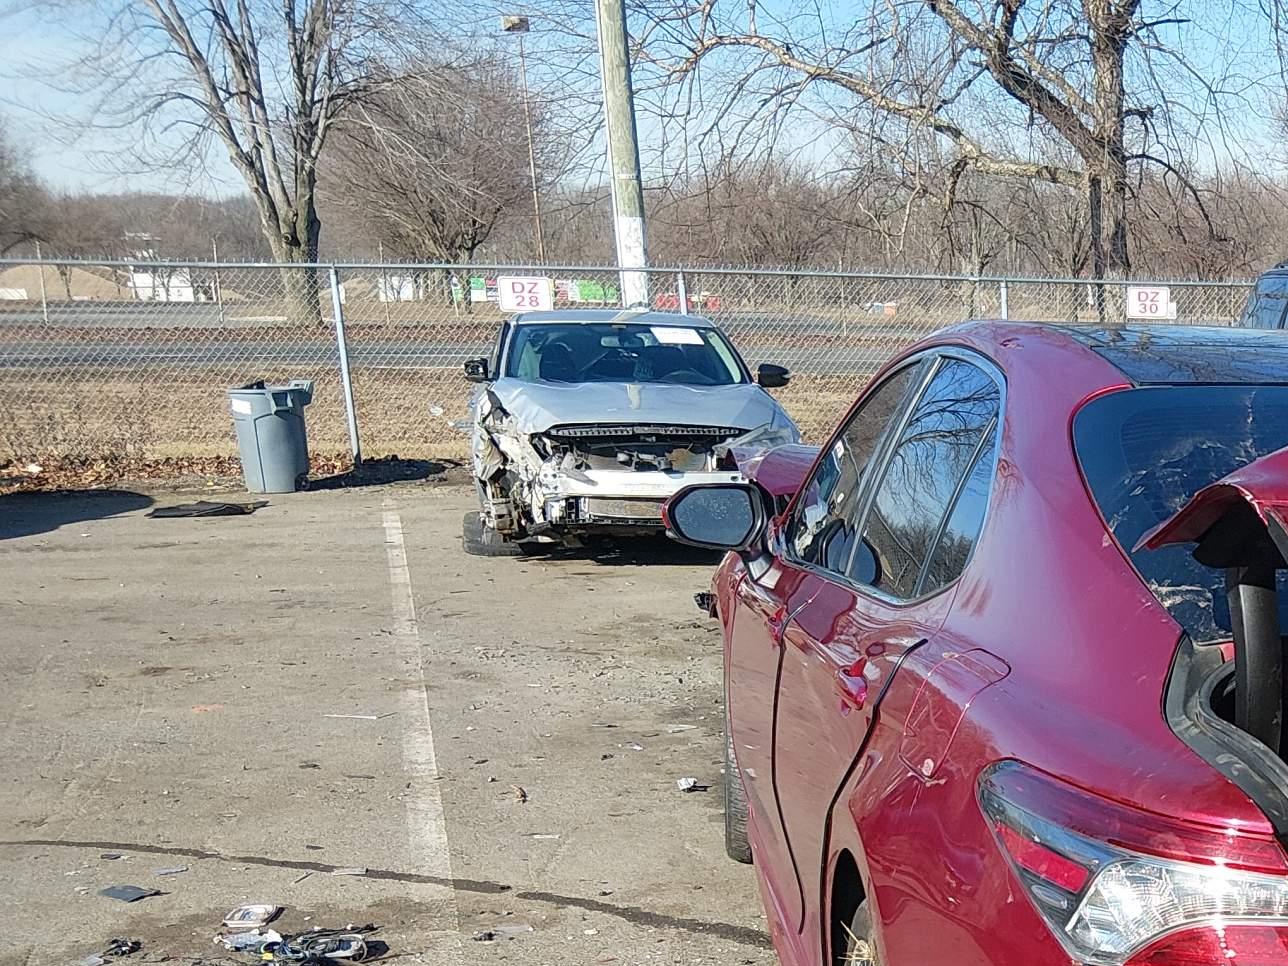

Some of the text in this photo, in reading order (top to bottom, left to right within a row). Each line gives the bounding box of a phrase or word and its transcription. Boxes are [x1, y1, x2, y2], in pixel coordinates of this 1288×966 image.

[512, 281, 539, 294] DZ
[514, 295, 540, 307] 28
[1137, 291, 1160, 302] DZ
[1138, 303, 1159, 314] 30
